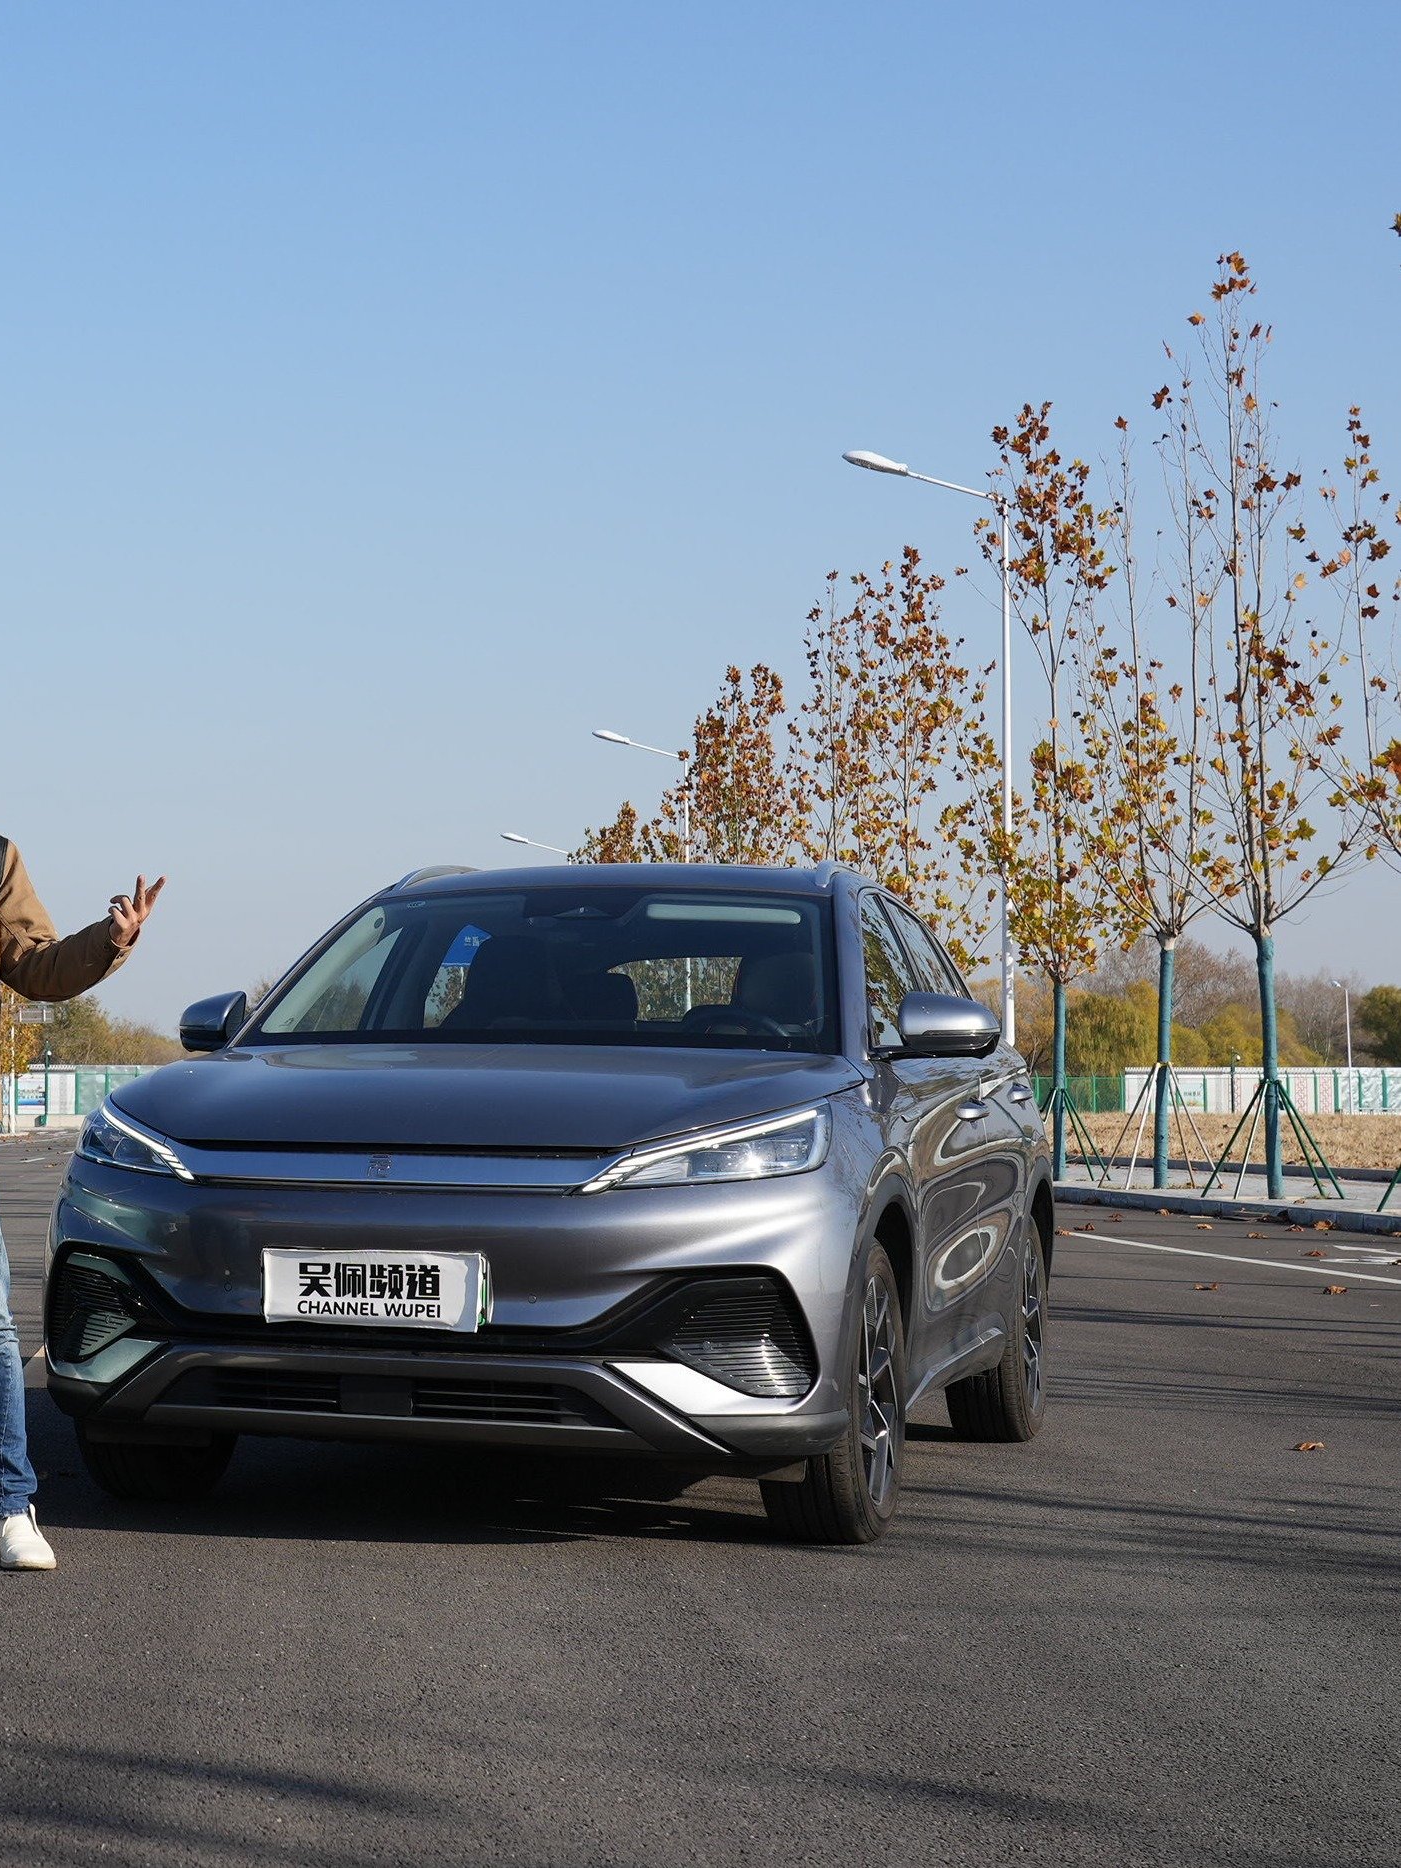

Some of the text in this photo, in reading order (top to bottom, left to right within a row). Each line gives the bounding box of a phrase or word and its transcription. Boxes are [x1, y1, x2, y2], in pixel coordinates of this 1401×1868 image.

[299, 1262, 440, 1300] 吴佩频道
[297, 1300, 441, 1317] CHANNEL WUPEI
